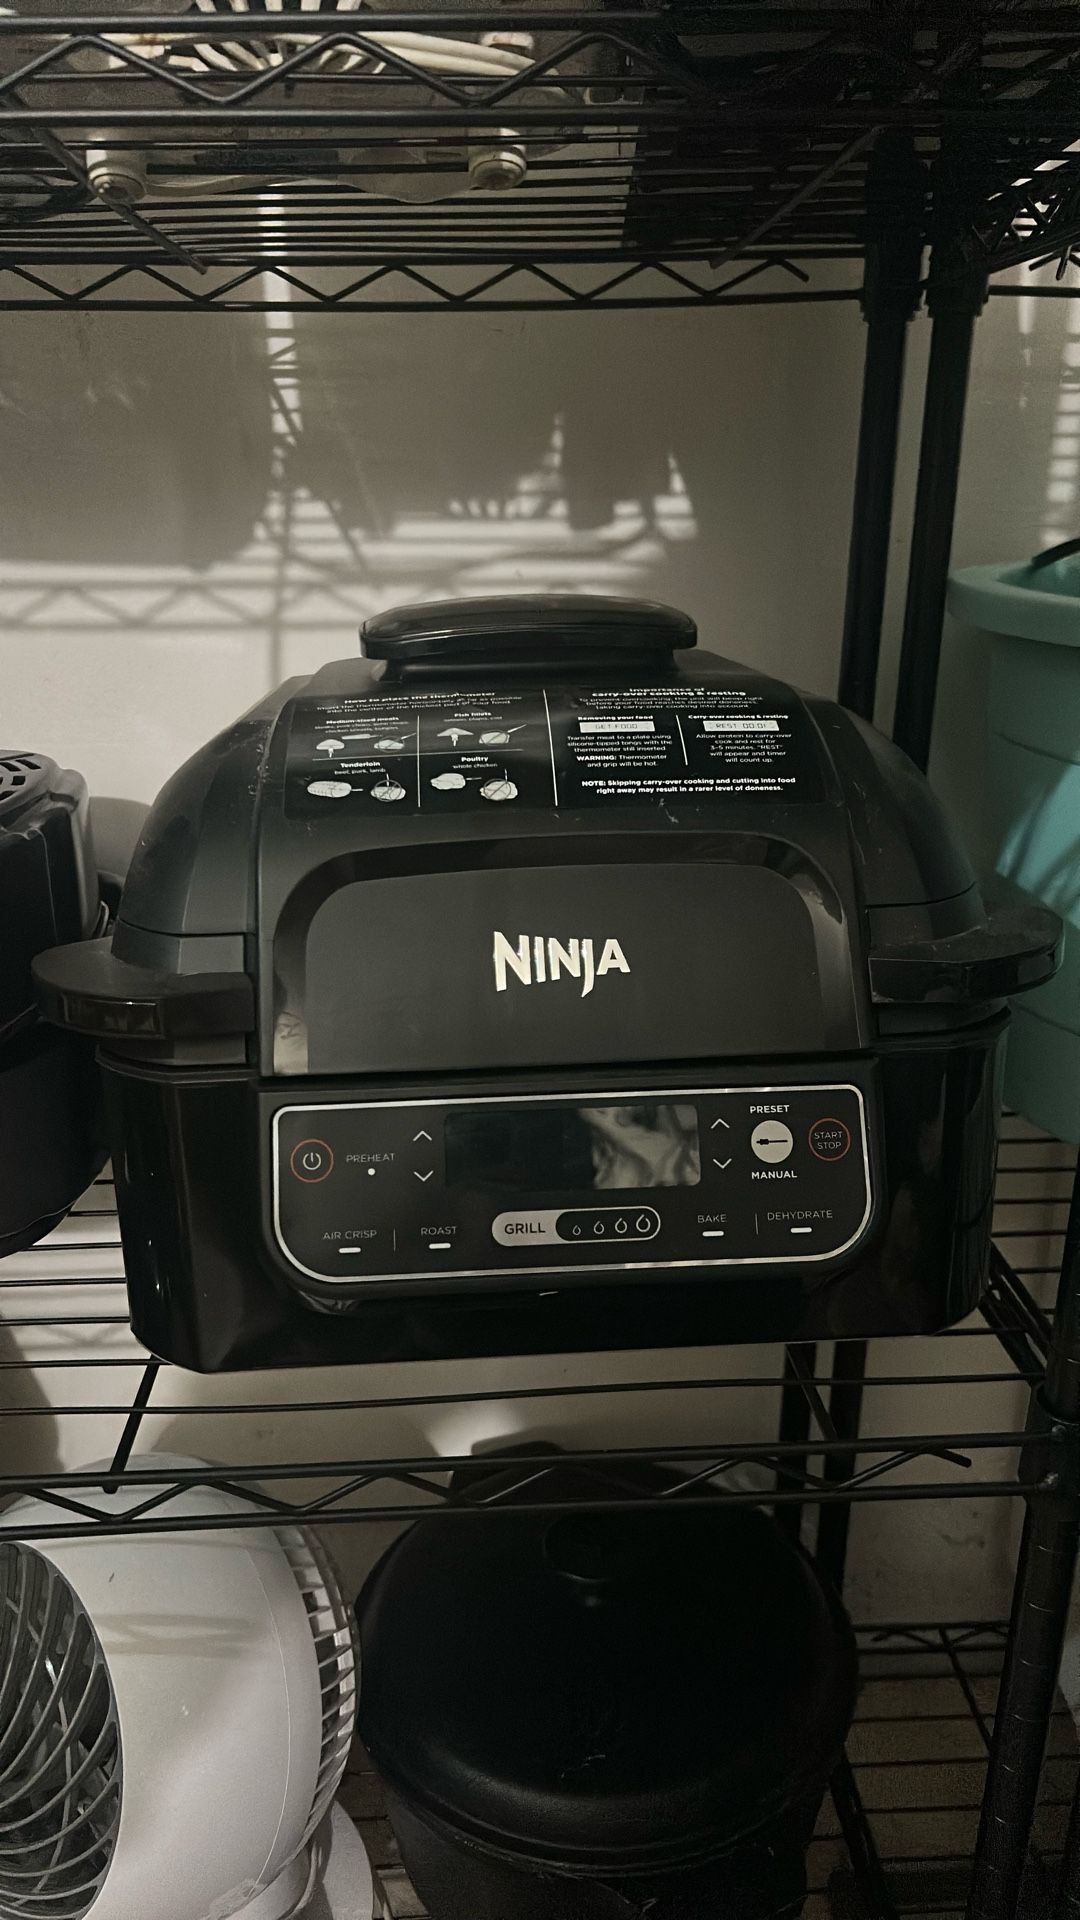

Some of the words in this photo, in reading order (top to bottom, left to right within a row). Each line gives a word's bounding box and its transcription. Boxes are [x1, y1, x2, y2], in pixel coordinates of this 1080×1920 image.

[340, 761, 381, 769] Tenderloin
[461, 756, 489, 764] Poultry
[493, 931, 631, 998] NINJA
[750, 1105, 790, 1114] PRESET
[814, 1131, 843, 1140] START
[817, 1141, 842, 1150] STOP
[346, 1153, 396, 1163] PREHEAT
[751, 1170, 798, 1180] MANUAL
[697, 1214, 727, 1224] BAKE
[767, 1210, 833, 1221] DEHYDRATE
[420, 1226, 458, 1236] ROAST
[504, 1222, 546, 1235] GRILL
[322, 1231, 342, 1241] AIR
[345, 1229, 377, 1240] CRISP
